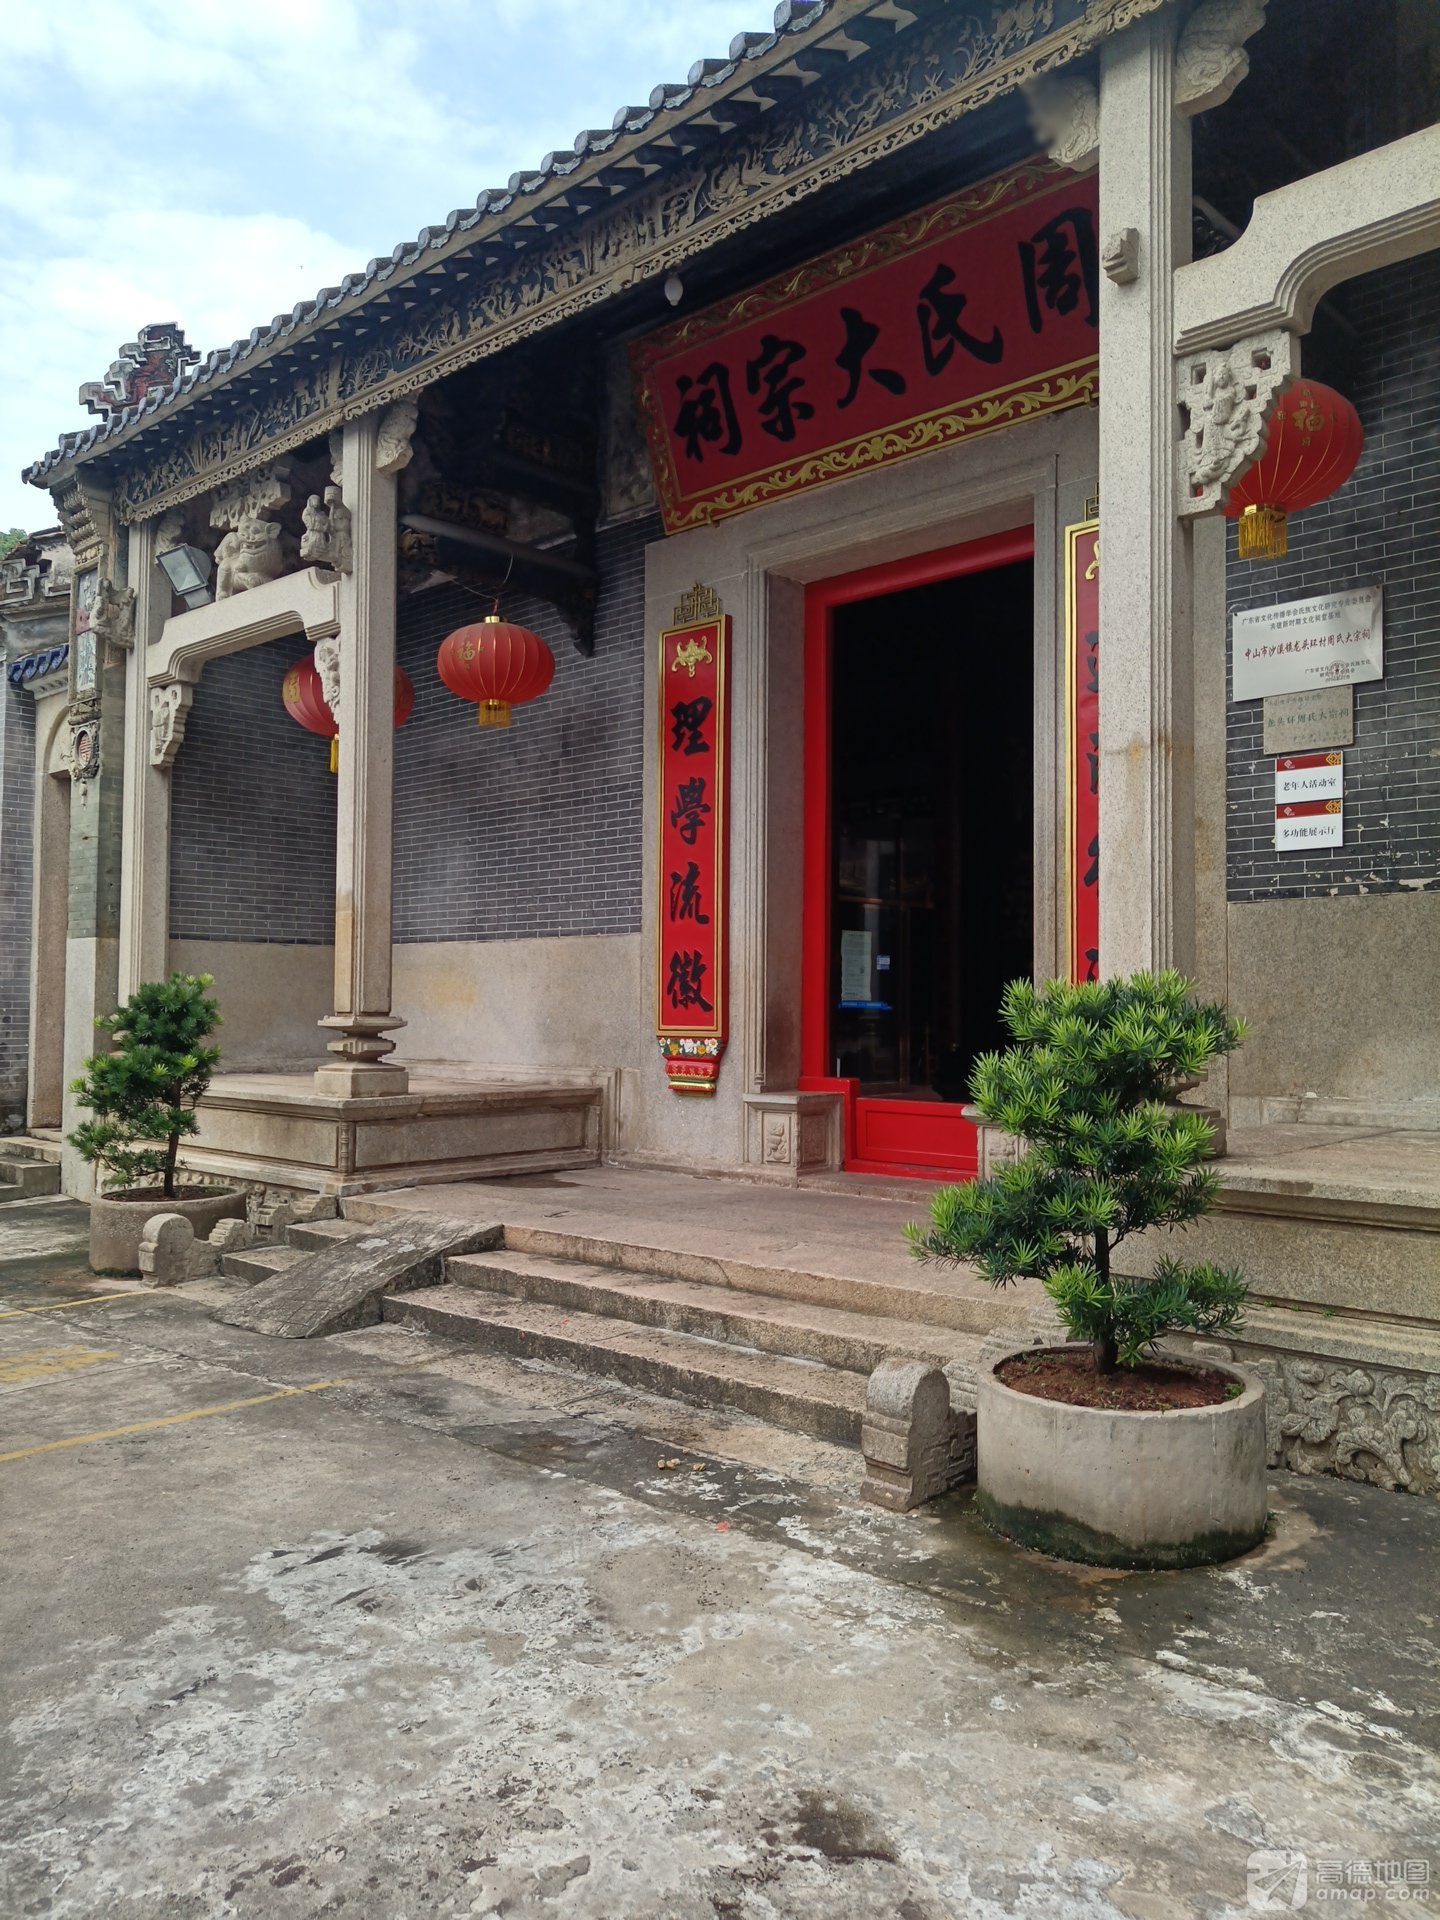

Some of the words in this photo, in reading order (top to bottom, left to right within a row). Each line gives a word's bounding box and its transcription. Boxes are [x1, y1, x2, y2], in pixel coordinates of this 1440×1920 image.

[1283, 777, 1337, 792] 老年人活动室
[1282, 826, 1337, 838] 多功能展示厅
